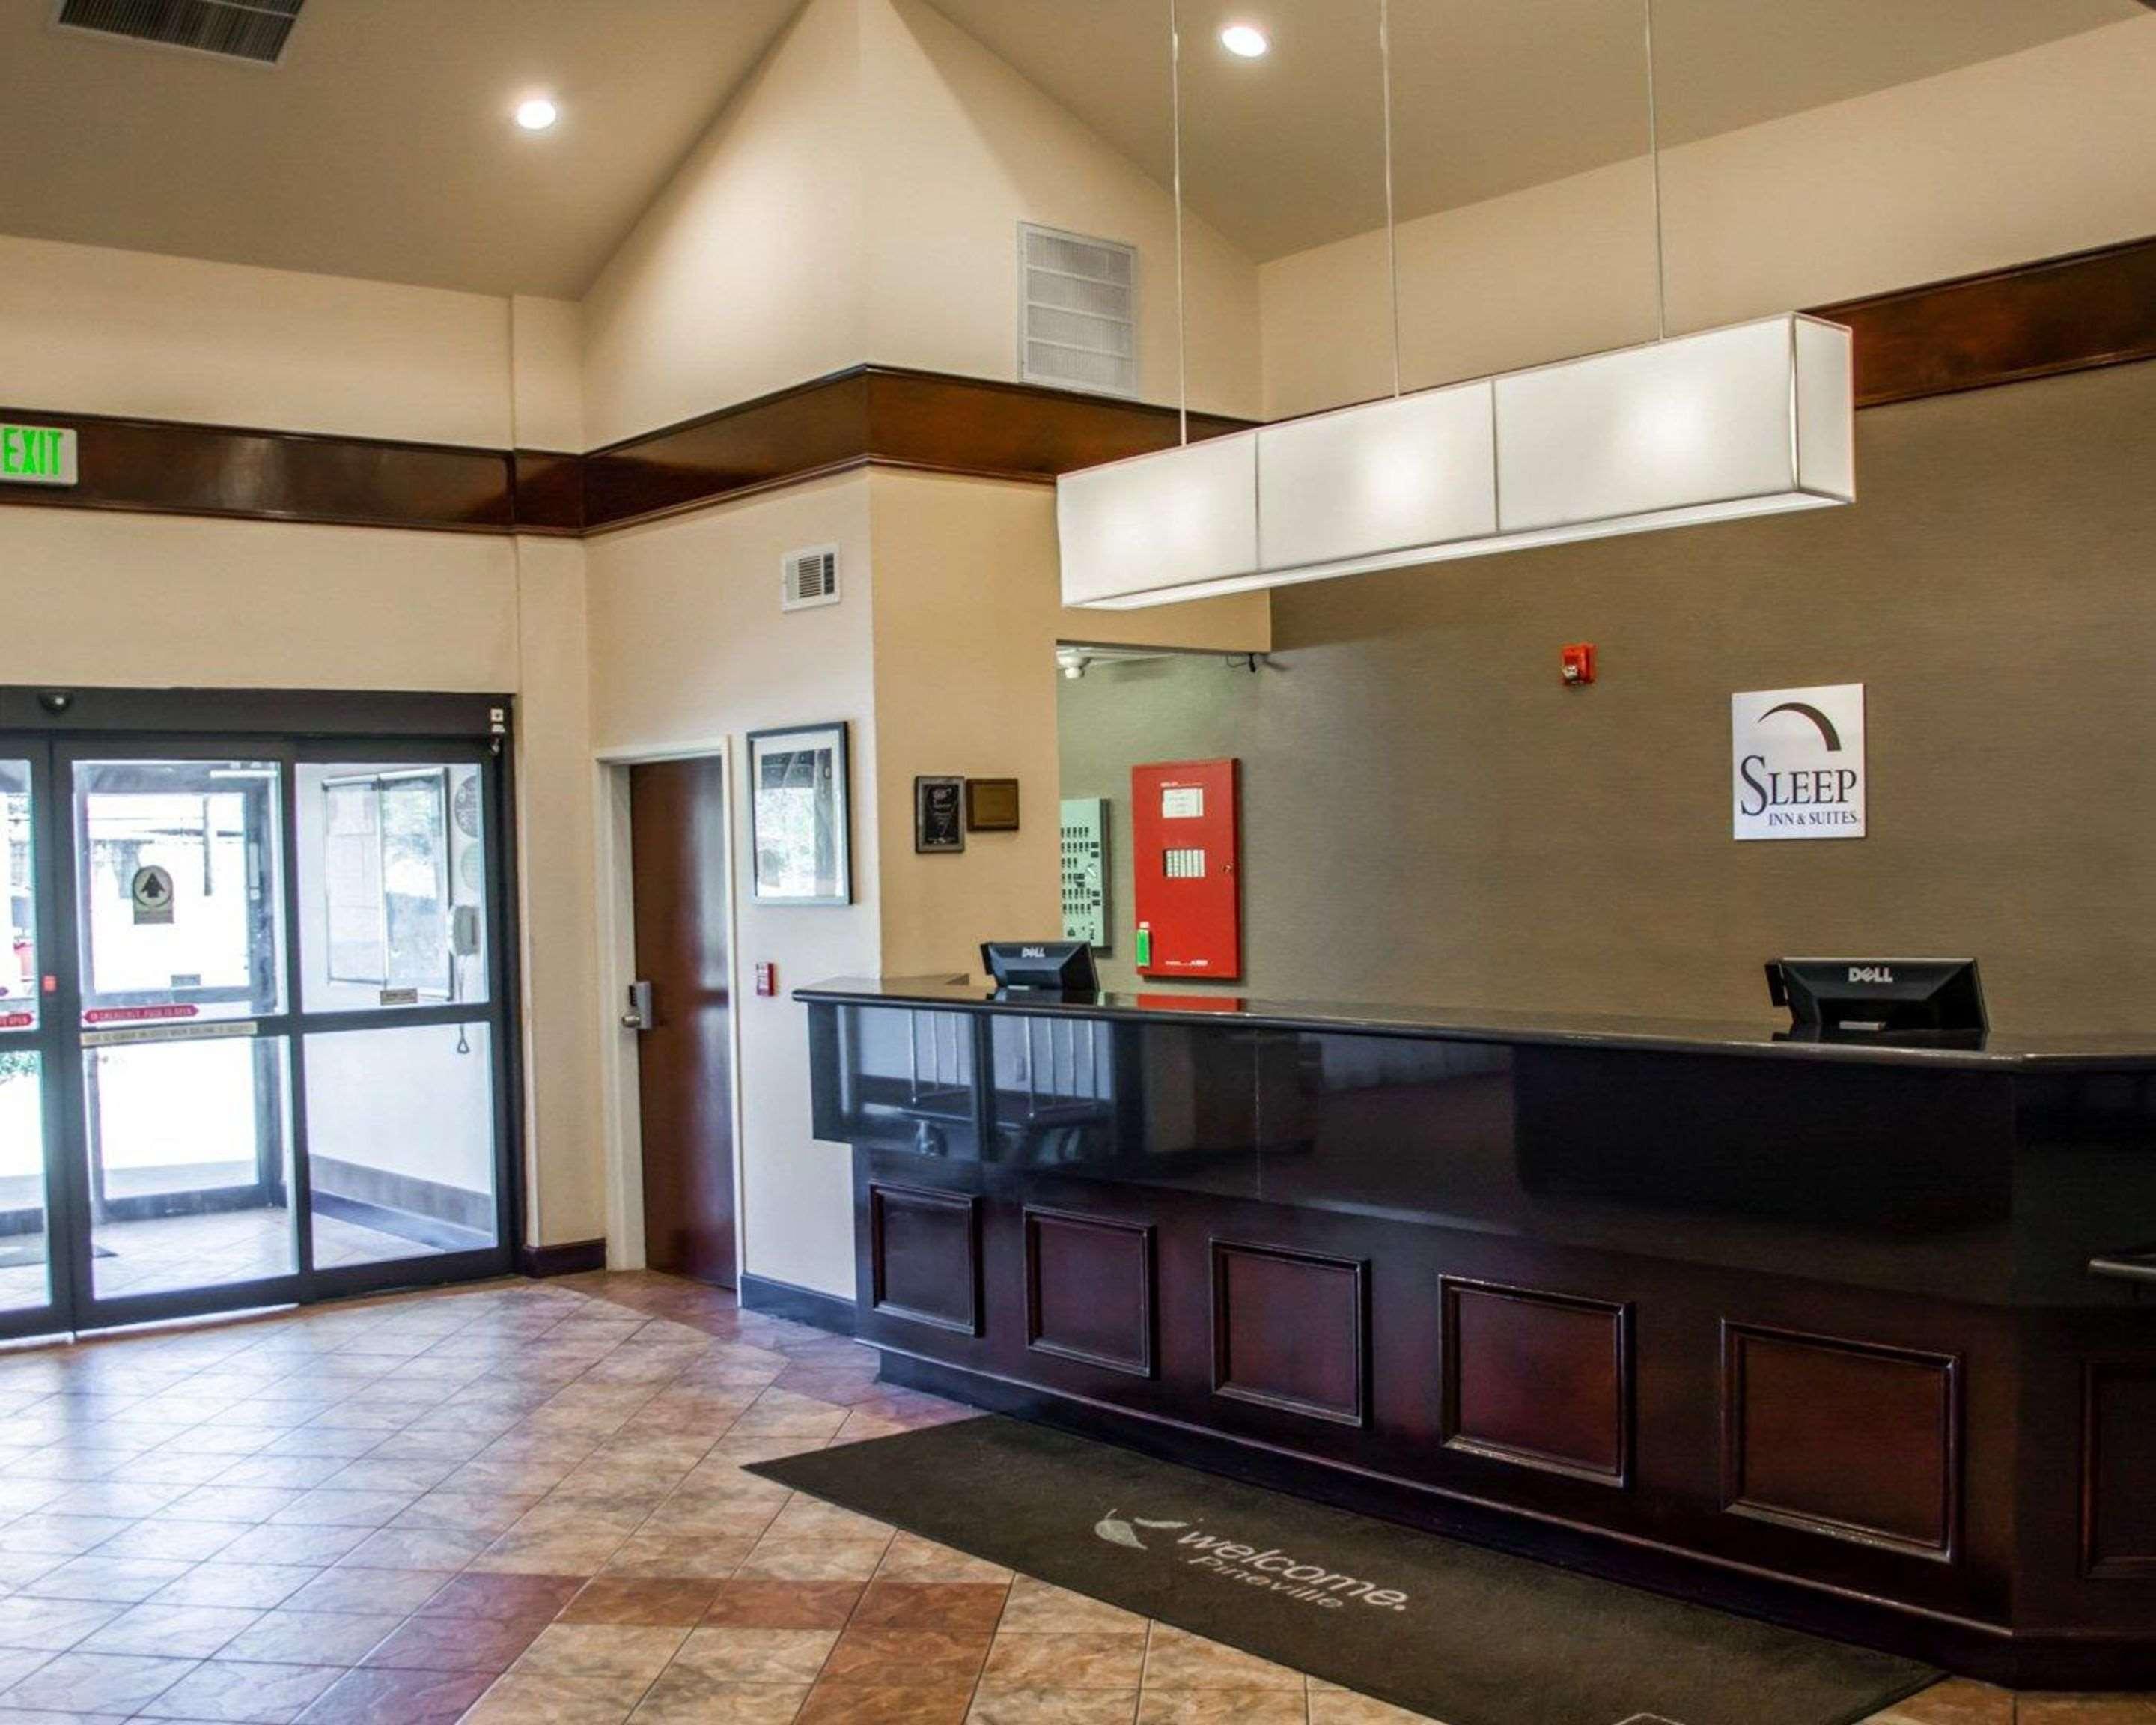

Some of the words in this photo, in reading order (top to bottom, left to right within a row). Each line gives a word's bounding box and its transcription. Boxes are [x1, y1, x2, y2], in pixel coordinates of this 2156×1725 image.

[4, 427, 63, 475] EXIT
[1740, 755, 1857, 816] SLEEP
[1769, 812, 1794, 826] INN
[1797, 813, 1806, 824] &
[1809, 811, 1857, 824] SUITES
[1021, 946, 1045, 958] DELL
[1848, 967, 1893, 982] DELL
[1188, 1556, 1343, 1608] Pineville
